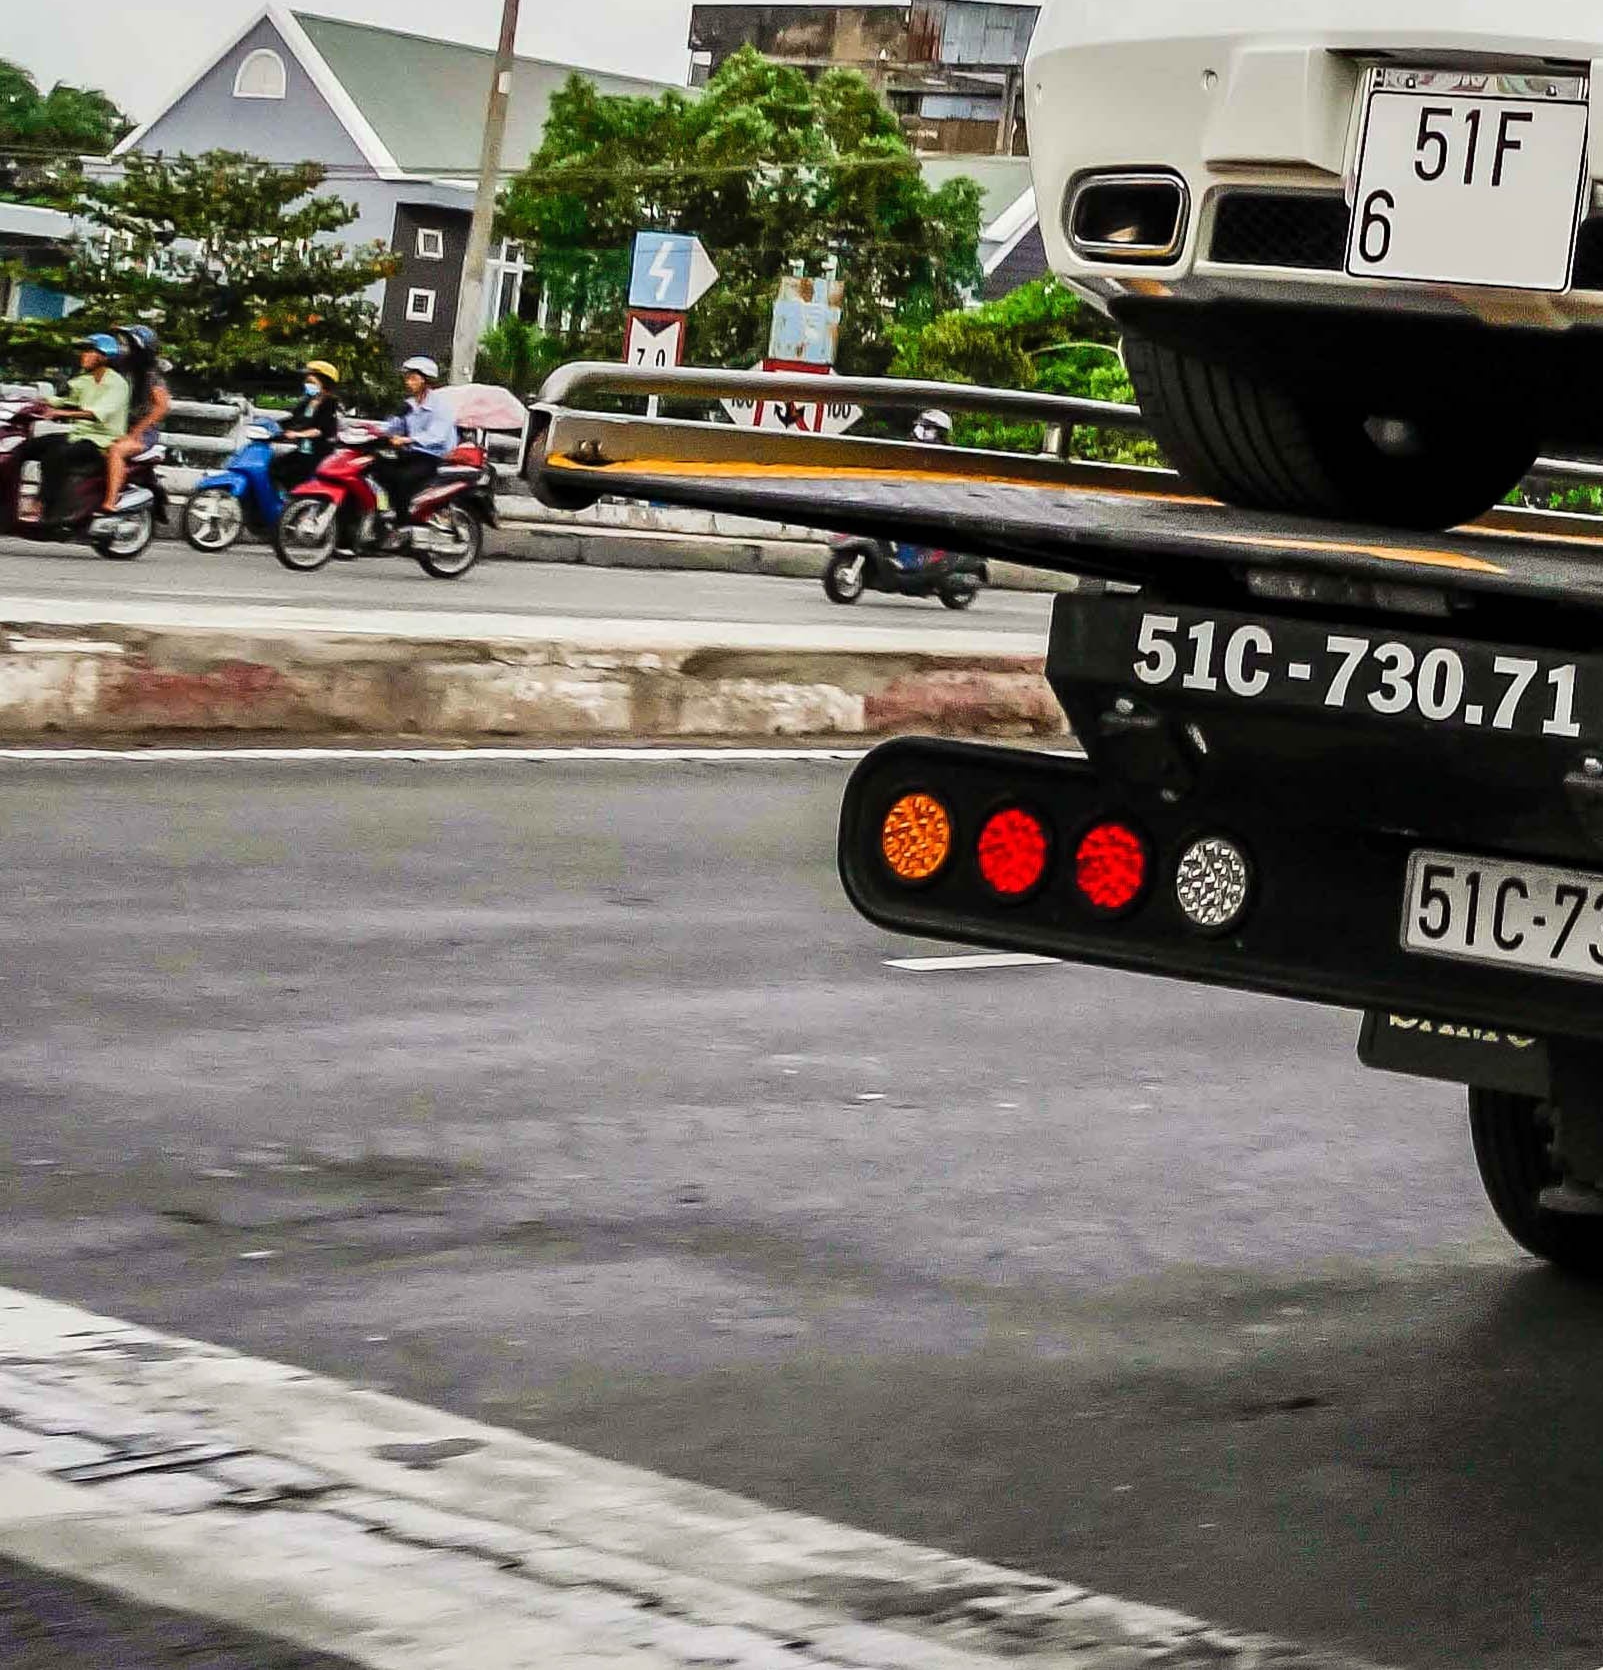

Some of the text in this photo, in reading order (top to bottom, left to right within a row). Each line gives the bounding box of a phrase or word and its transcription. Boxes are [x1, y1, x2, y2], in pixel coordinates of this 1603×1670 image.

[1413, 106, 1533, 187] 51F
[1358, 189, 1395, 263] 6
[1133, 613, 1581, 738] 51C-730.71
